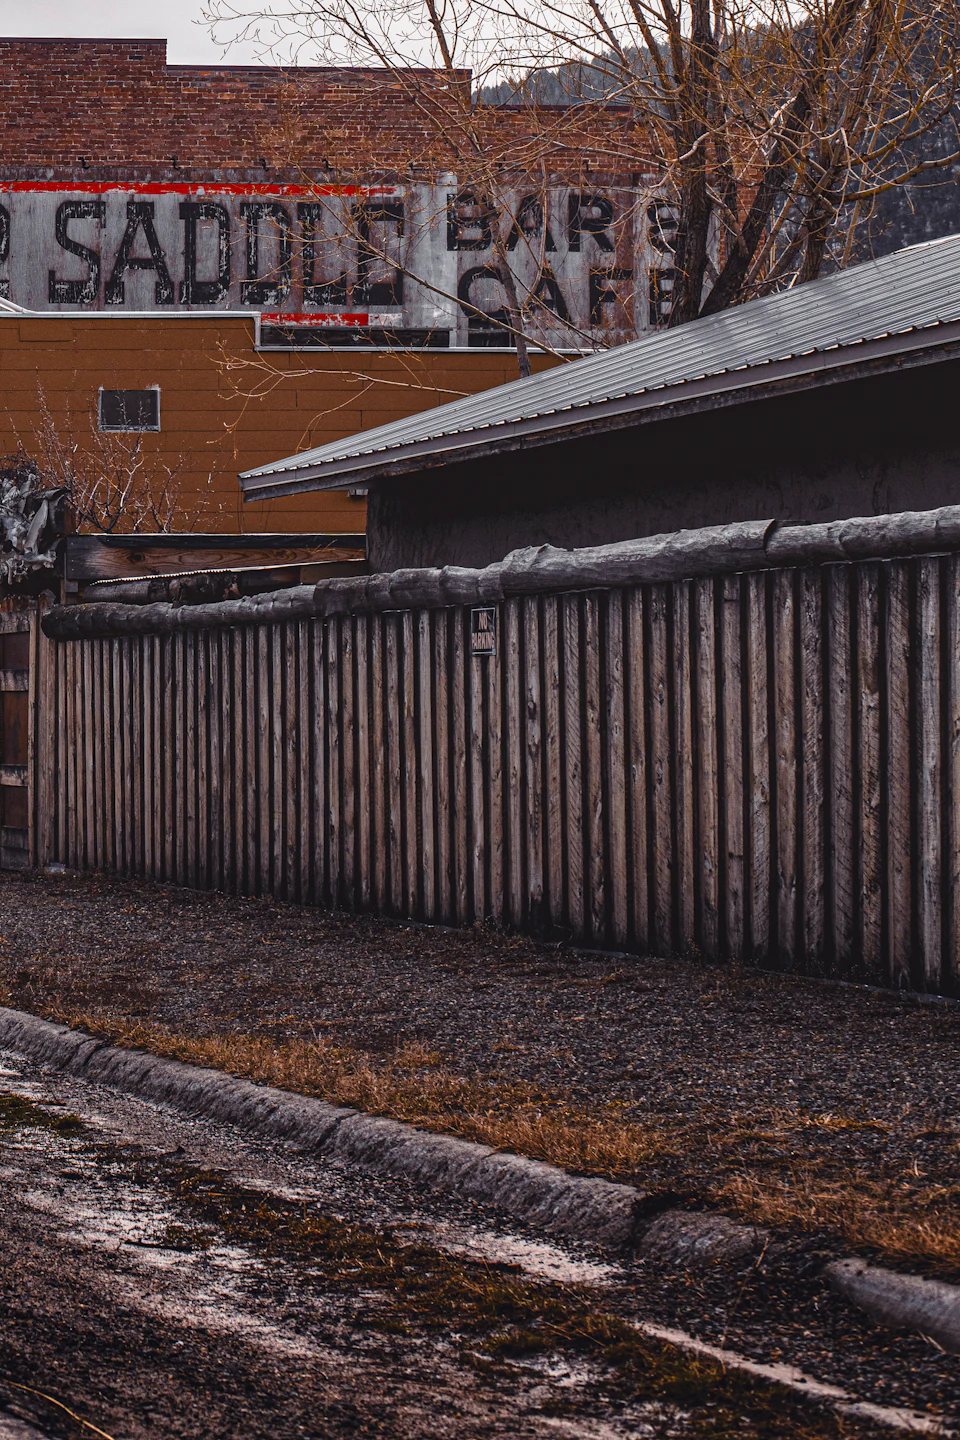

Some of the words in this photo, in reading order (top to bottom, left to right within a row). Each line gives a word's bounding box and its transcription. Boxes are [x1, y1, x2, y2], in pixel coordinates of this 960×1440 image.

[48, 200, 404, 305] SADDLE
[478, 612, 488, 630] NO
[471, 632, 495, 650] PARKING
